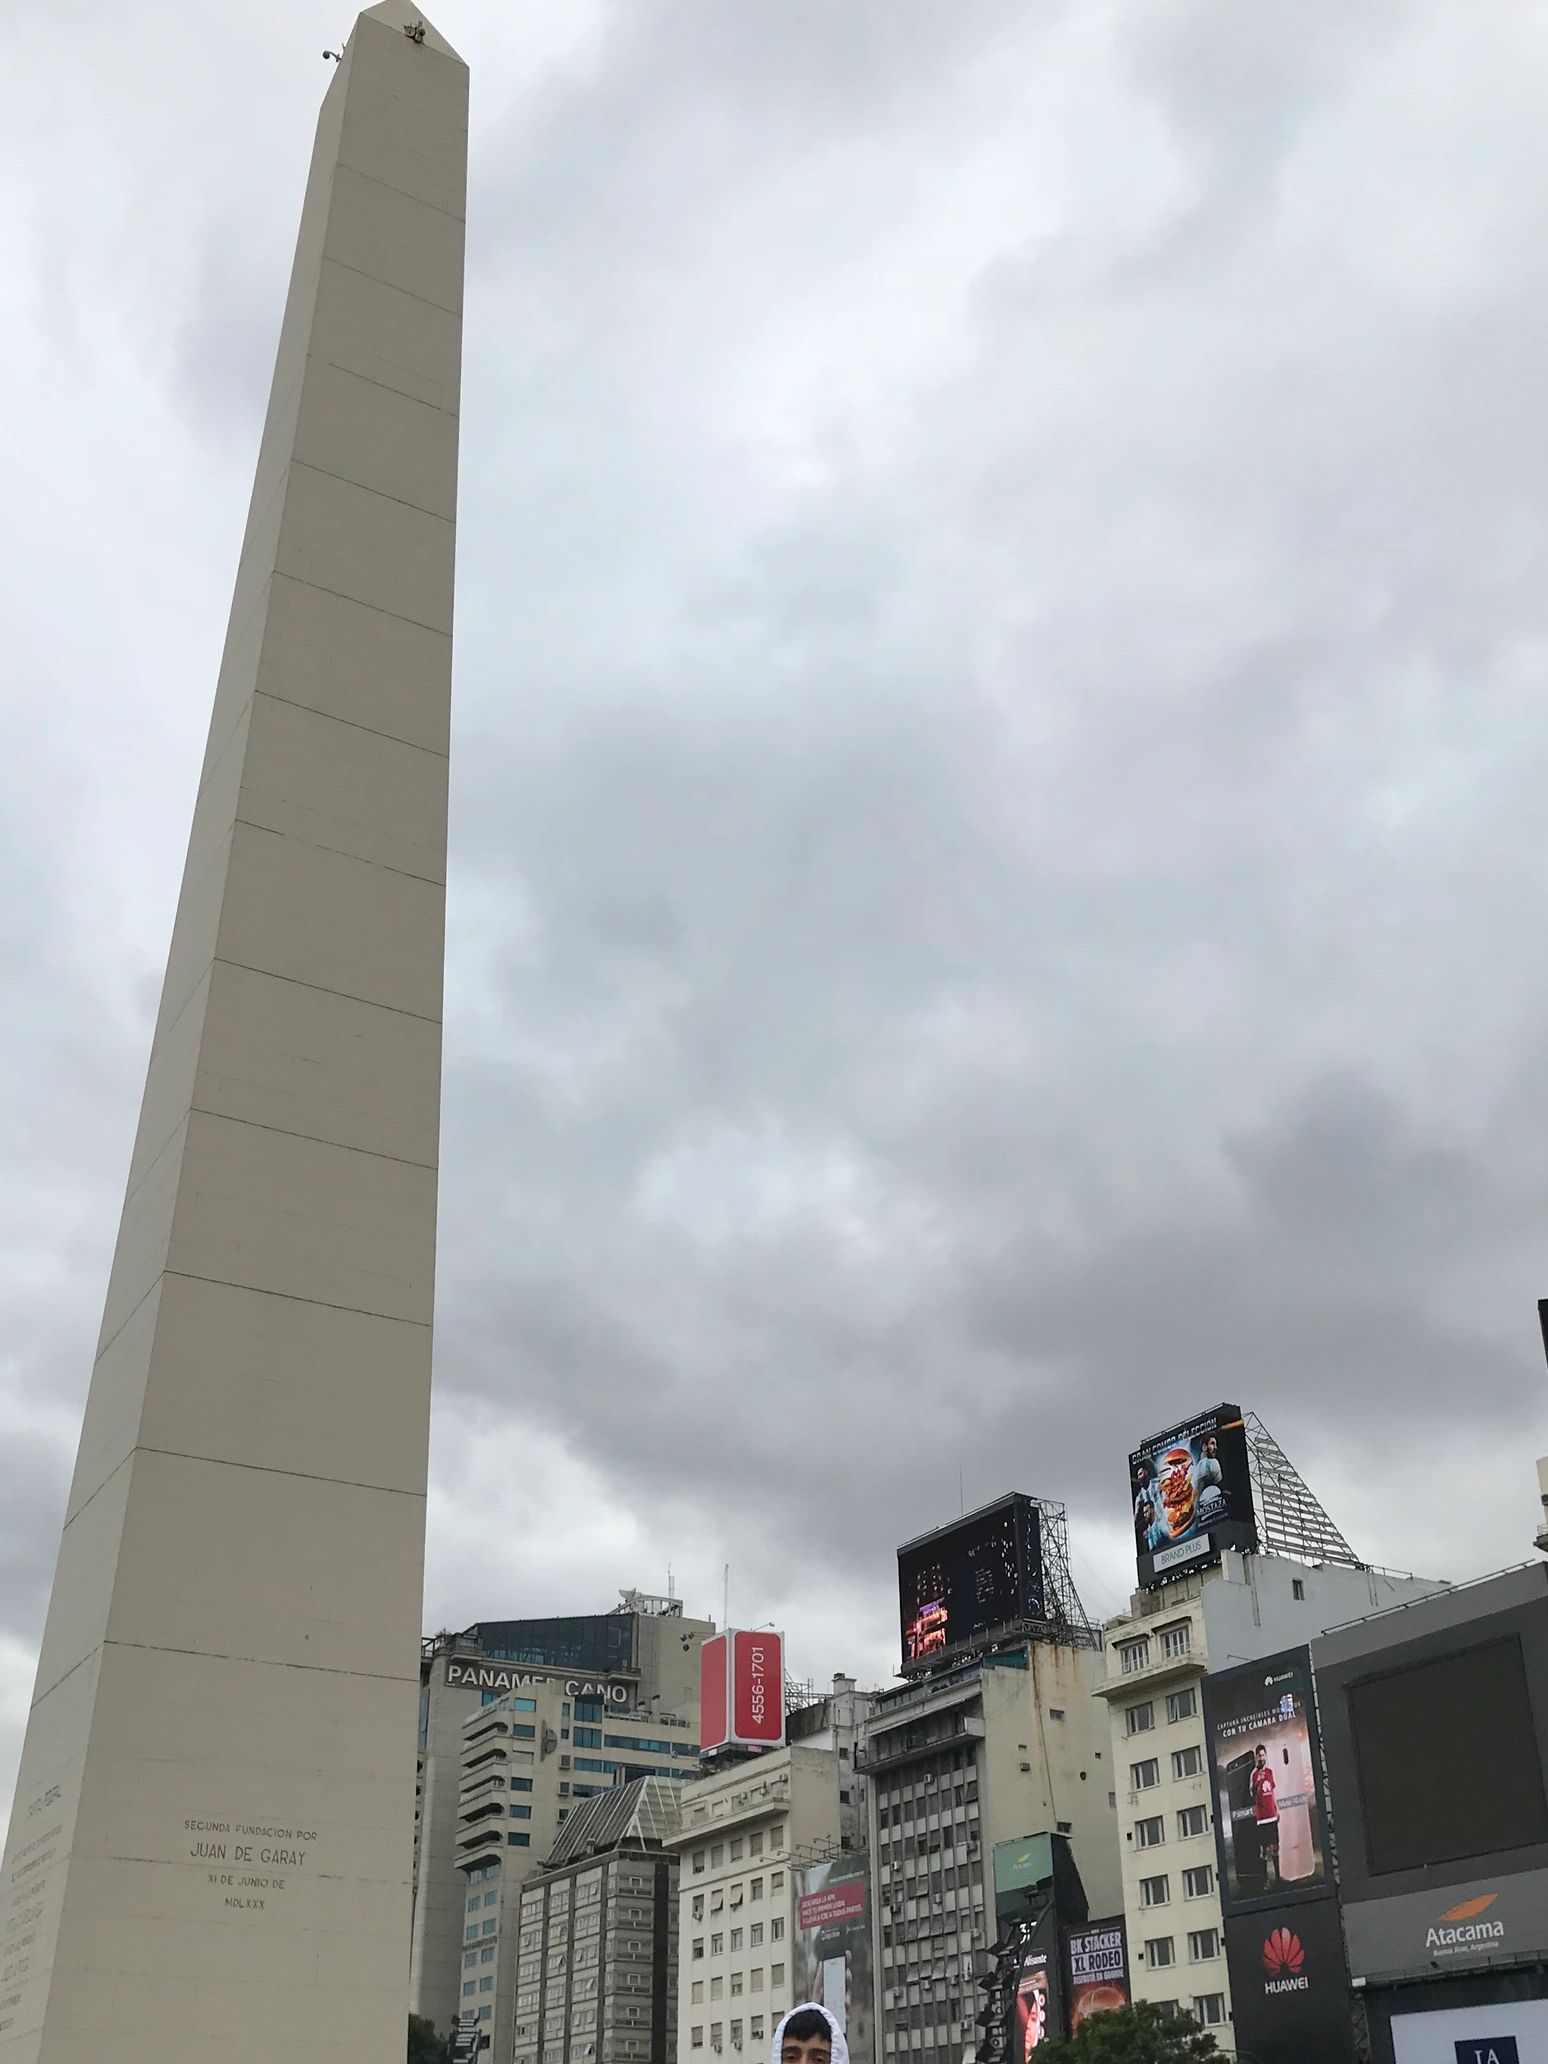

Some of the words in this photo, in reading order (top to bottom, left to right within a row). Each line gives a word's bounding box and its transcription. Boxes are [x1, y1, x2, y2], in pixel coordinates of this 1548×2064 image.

[1132, 1447, 1152, 1464] GRAN
[1197, 1498, 1227, 1516] MOSTAZA
[1161, 1546, 1185, 1565] BRAND
[1186, 1541, 1201, 1556] PLUS
[752, 1647, 764, 1724] 4556-1701
[1223, 1728, 1237, 1738] CON
[1238, 1724, 1247, 1734] TU
[1278, 1711, 1296, 1722] DUAL
[184, 1820, 231, 1833] SEGUNDA
[235, 1824, 292, 1839] FUNDACION
[297, 1830, 318, 1841] POR
[190, 1842, 227, 1860] JUAN
[234, 1846, 253, 1861] DE
[260, 1848, 306, 1865] GARAY
[220, 1875, 234, 1886] DE
[238, 1876, 269, 1888] JUNIO
[272, 1879, 285, 1890] DE
[1070, 1938, 1083, 1955] BK
[1085, 1931, 1121, 1952] STACKER
[1425, 1921, 1504, 1947] Atacama
[1074, 1956, 1086, 1973] XL
[1089, 1950, 1121, 1970] RODEO
[1264, 1976, 1309, 1994] HUAWEI
